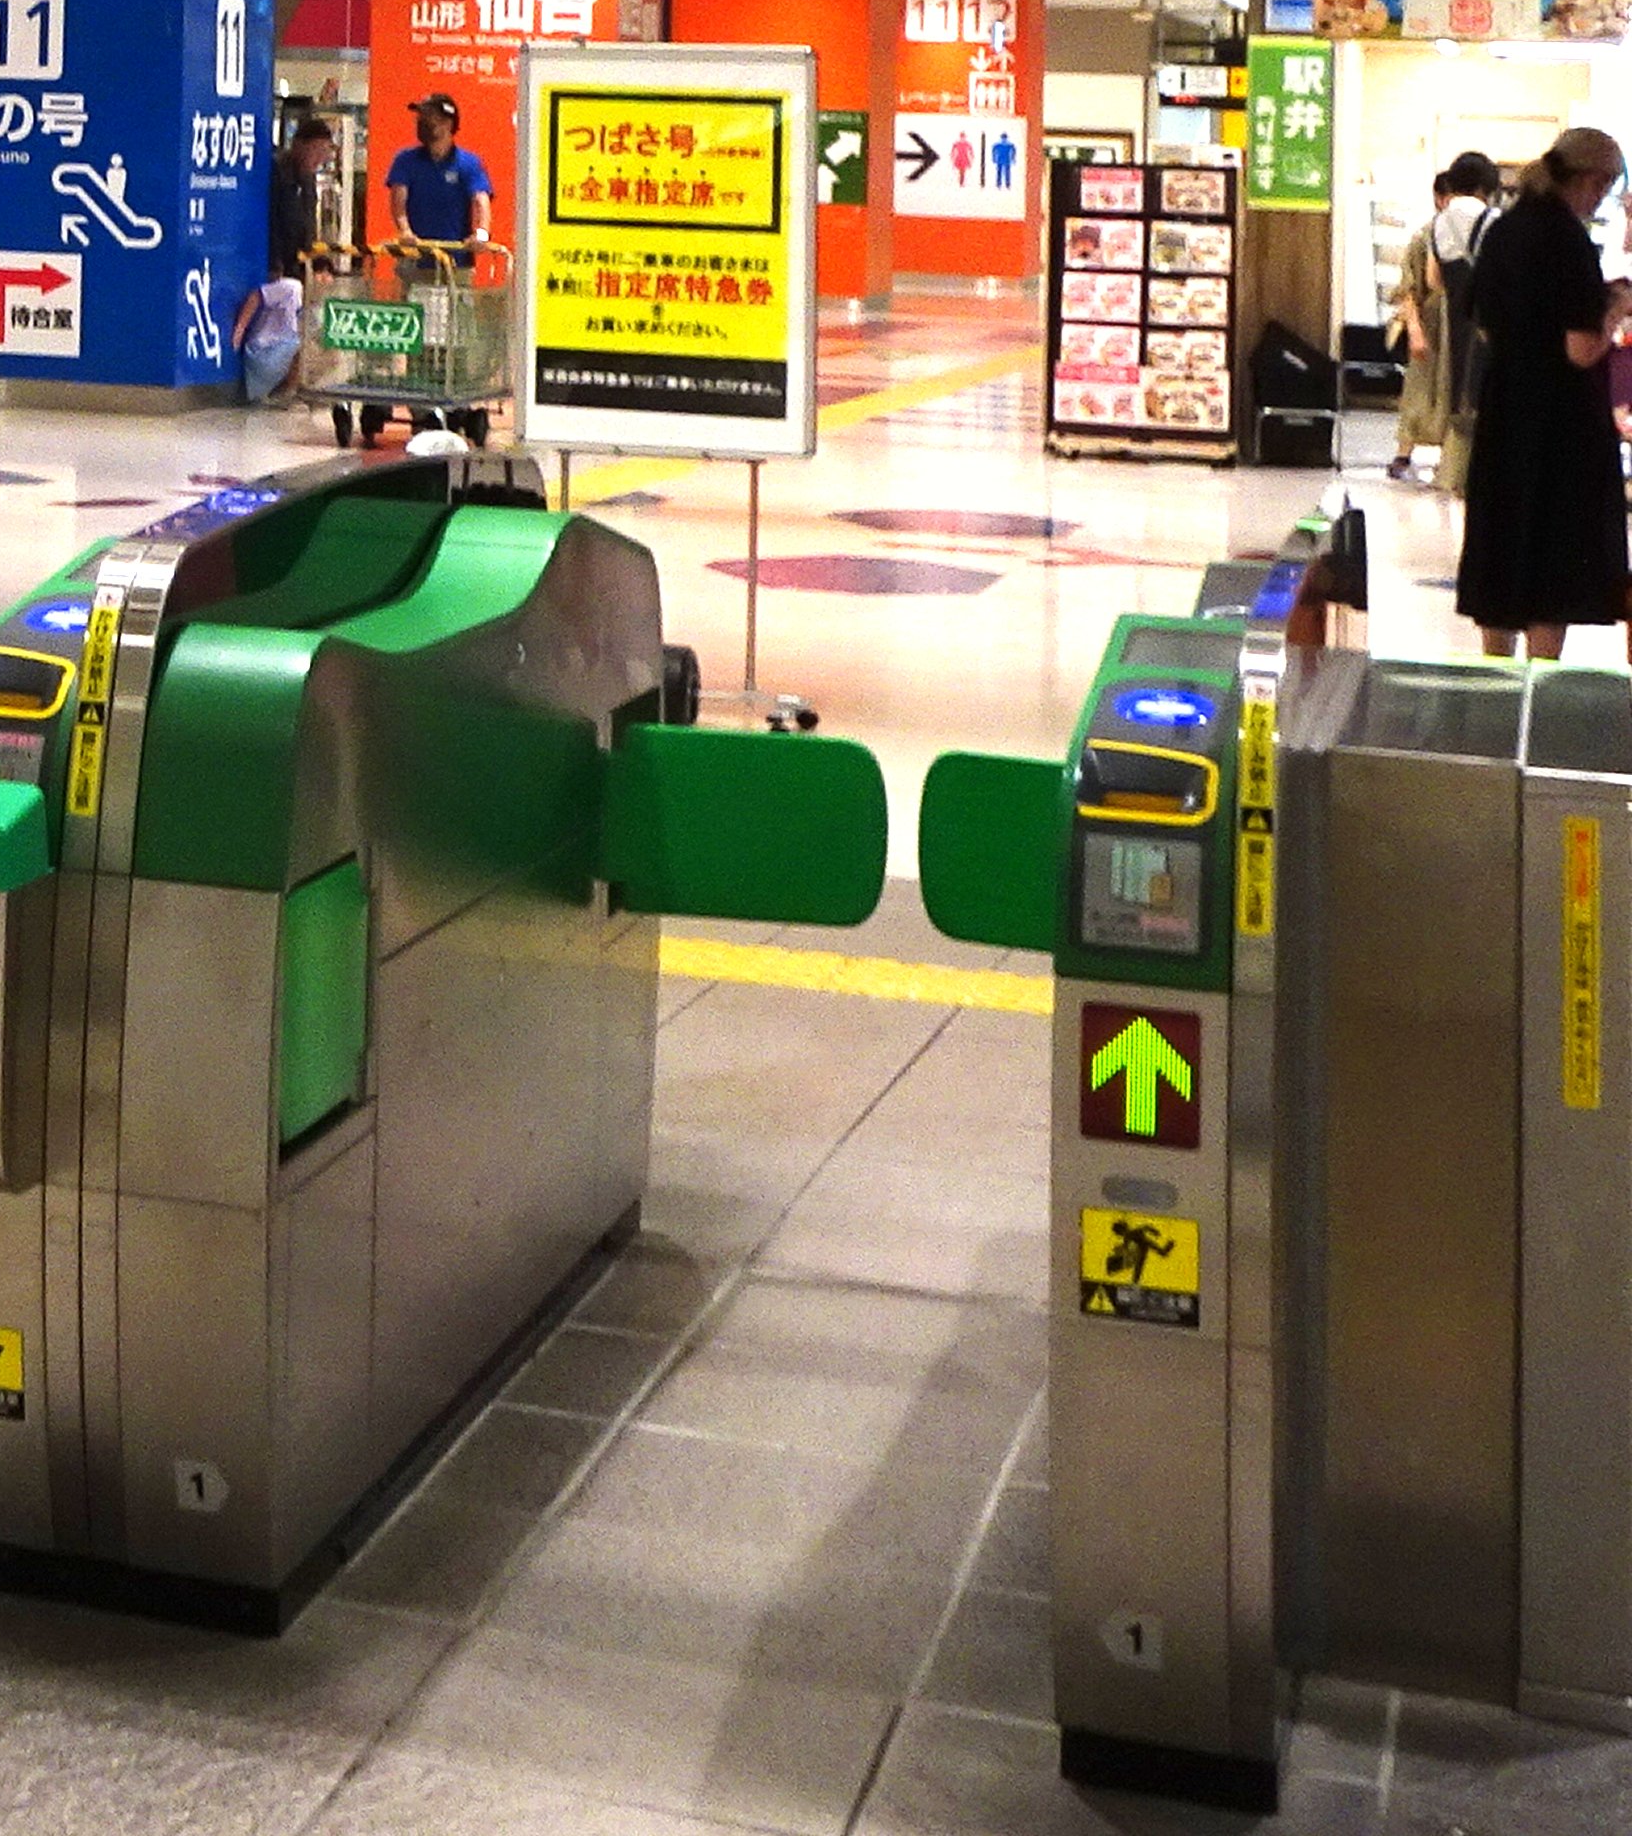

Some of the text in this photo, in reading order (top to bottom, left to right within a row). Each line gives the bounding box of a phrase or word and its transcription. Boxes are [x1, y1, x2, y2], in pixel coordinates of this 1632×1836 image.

[411, 0, 465, 31] 山形
[218, 4, 245, 84] 11
[191, 110, 256, 172] なすの号
[564, 121, 698, 160] つばさ号
[11, 303, 73, 332] 待合室
[190, 1472, 208, 1501] 1
[1125, 1622, 1144, 1656] 1
